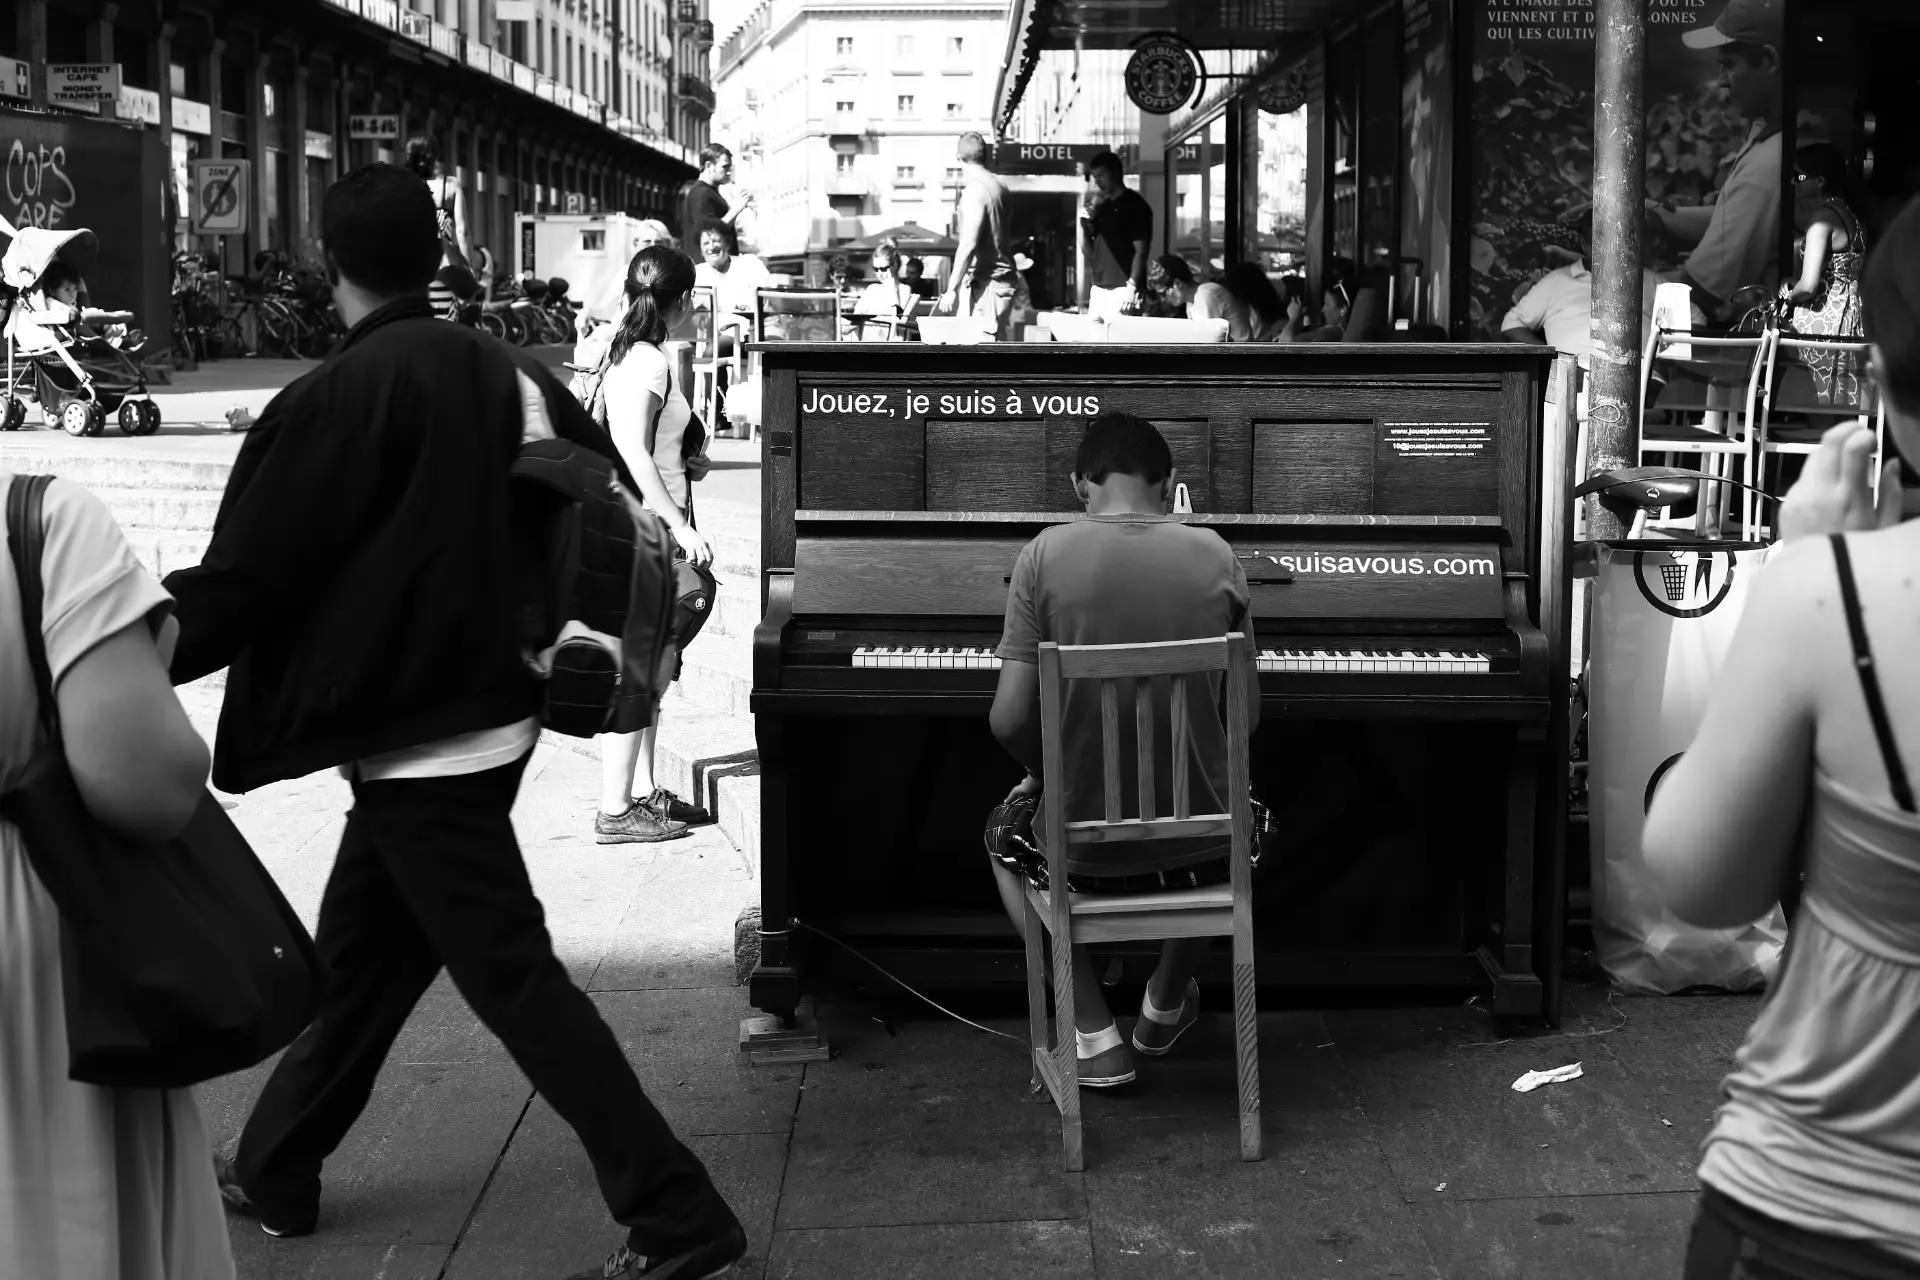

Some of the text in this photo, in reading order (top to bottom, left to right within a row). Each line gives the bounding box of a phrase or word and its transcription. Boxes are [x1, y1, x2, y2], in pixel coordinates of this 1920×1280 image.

[1487, 10, 1557, 23] VIENNENT
[1563, 11, 1580, 23] ET
[1648, 11, 1697, 23] ONNES
[1487, 27, 1596, 40] QUI LES CULTIV
[1131, 46, 1190, 75] STARBUCKS
[53, 66, 110, 74] INTERNET
[66, 73, 98, 82] CAFE
[53, 92, 113, 100] TRANSFER
[1138, 90, 1182, 107] COFFEE
[1020, 146, 1074, 160] HOTEL
[6, 139, 76, 208] COPS
[208, 168, 229, 177] ZONE
[14, 202, 64, 229] ARE
[802, 389, 1100, 419] Jouez, je suis à vous
[1390, 428, 1485, 436] www.jouezjesuisavous.com
[1254, 551, 1495, 575] suisavous.com
